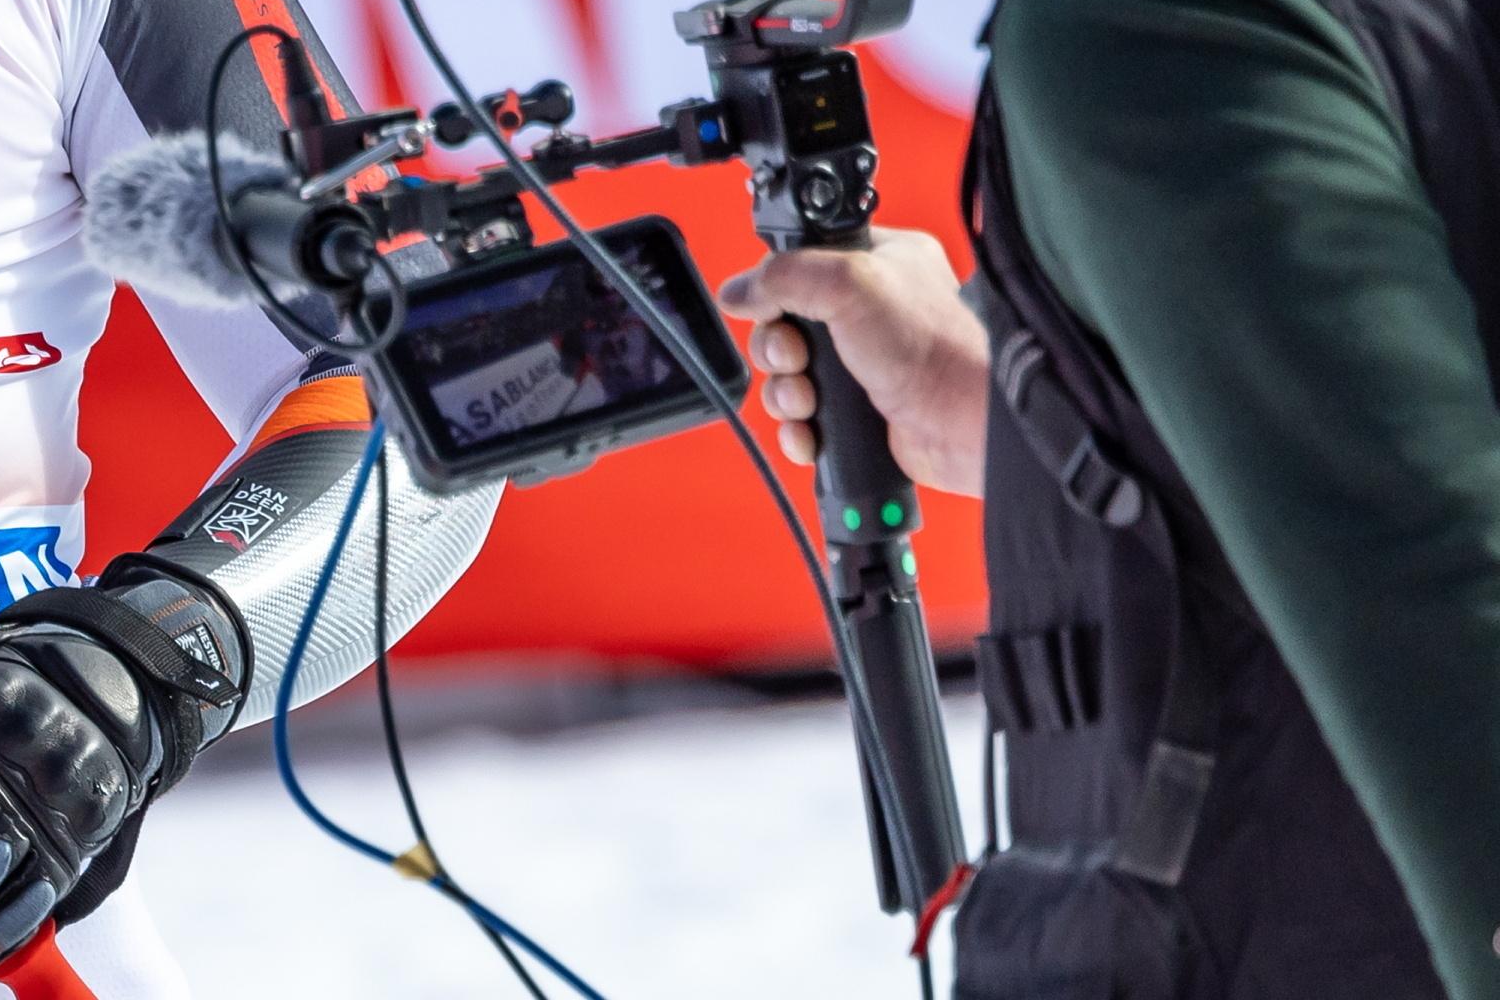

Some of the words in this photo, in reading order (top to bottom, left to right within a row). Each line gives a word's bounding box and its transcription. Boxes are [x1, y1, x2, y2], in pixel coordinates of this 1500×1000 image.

[234, 490, 285, 516] DEER
[249, 482, 289, 505] VAN
[195, 625, 221, 671] HESTRA
